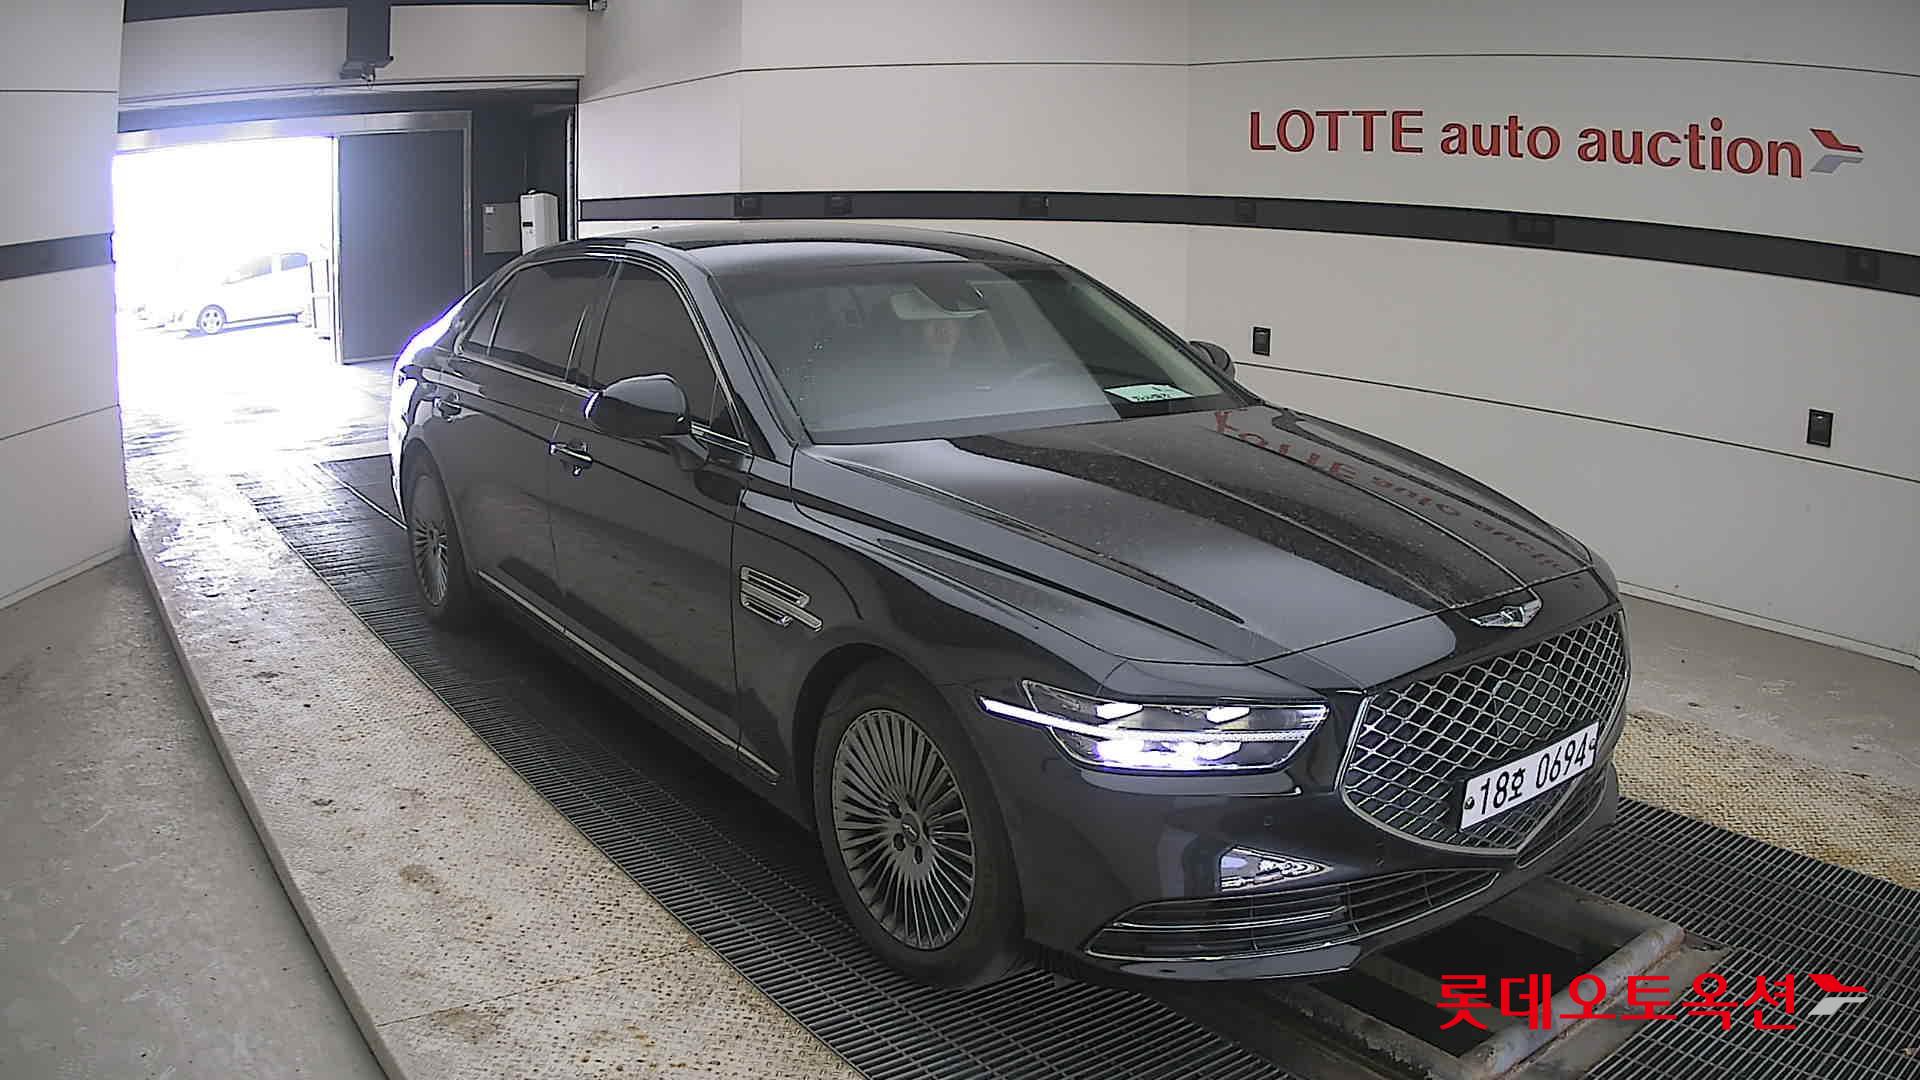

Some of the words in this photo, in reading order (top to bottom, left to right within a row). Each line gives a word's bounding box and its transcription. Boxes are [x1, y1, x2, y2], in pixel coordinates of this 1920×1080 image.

[1249, 110, 1424, 153] LOTTE
[1440, 115, 1561, 160] auto
[1577, 117, 1803, 178] auction
[1480, 767, 1526, 815] 18호
[1536, 732, 1588, 789] 0694
